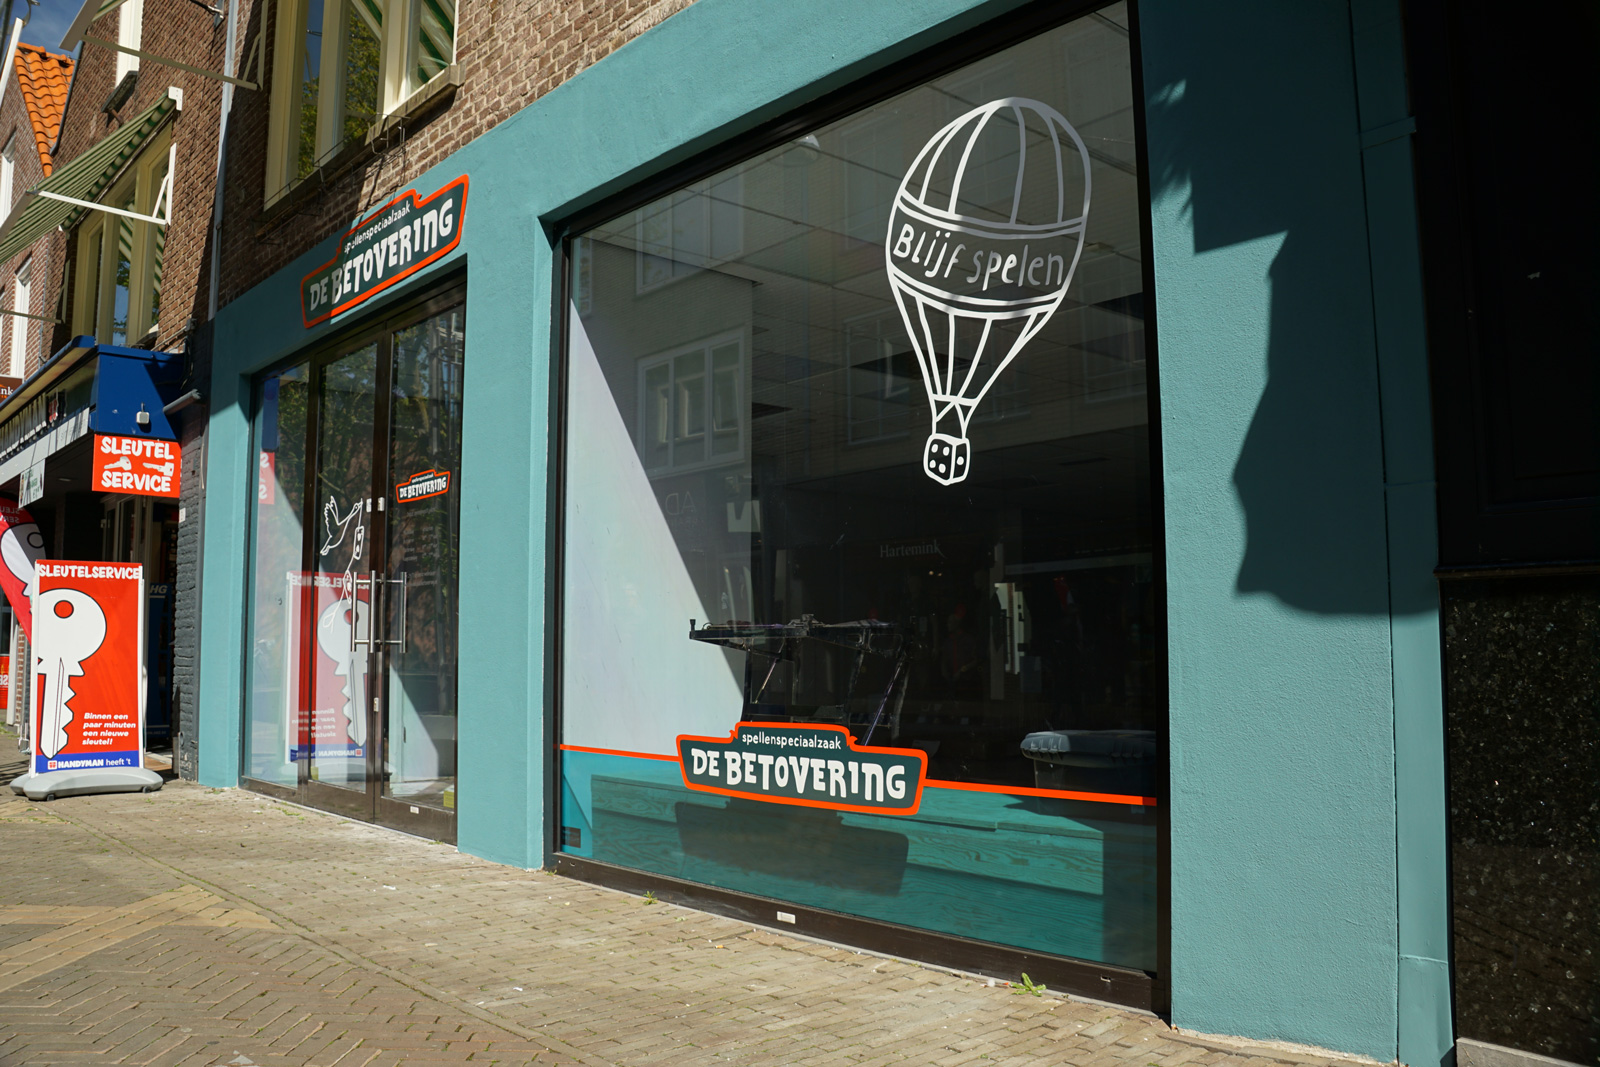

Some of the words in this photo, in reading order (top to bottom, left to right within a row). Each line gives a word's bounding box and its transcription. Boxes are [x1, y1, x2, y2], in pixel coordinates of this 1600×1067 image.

[344, 200, 411, 254] spellenspeciaalzaak
[310, 276, 329, 311] DE
[331, 198, 453, 305] BETOVERING
[893, 223, 966, 279] Blijf
[966, 244, 1064, 291] spelen
[101, 437, 174, 460] SLEUTEL
[101, 470, 171, 493] SERVICE
[399, 487, 408, 498] DE
[408, 476, 447, 499] BETOVERING
[880, 538, 948, 559] Hartemink
[38, 564, 141, 580] SLEUTELSERVICE
[149, 584, 168, 594] HG
[83, 721, 103, 730] paar
[104, 721, 136, 729] minuten
[84, 712, 112, 720] Binnen
[82, 738, 113, 746] sleutel!
[100, 729, 129, 737] nieuwe
[741, 731, 842, 750] spellenspeciaalzaak
[57, 758, 104, 769] HANDYMAN
[105, 757, 125, 767] heeft
[690, 747, 720, 777] DE
[724, 750, 906, 803] BETOVERING
